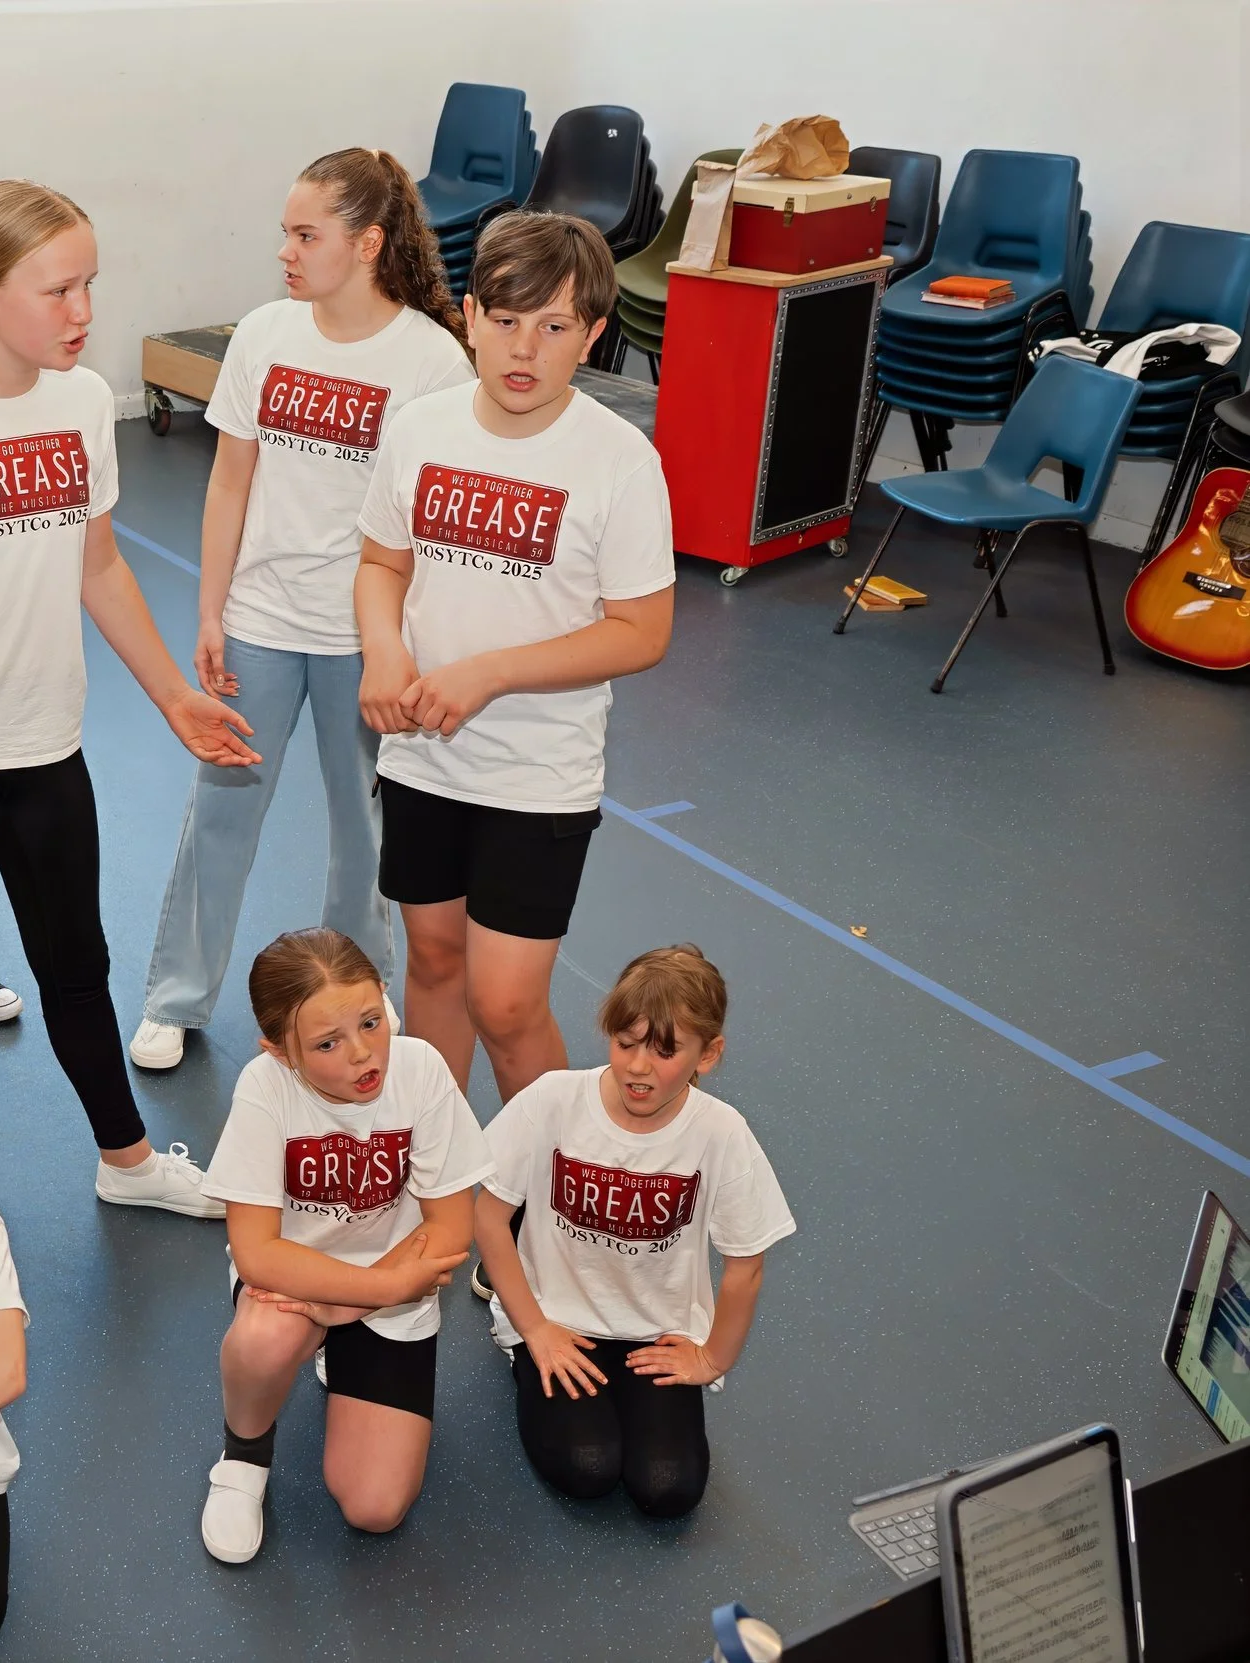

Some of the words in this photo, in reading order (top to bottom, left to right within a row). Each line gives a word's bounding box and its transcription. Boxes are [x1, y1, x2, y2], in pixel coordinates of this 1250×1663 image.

[294, 373, 307, 384] WE
[308, 377, 320, 387] GO
[322, 380, 362, 397] TOGETHER
[269, 382, 377, 433] GREASE
[280, 418, 298, 430] THE
[304, 424, 348, 441] MUSICAL
[2, 444, 14, 456] GO
[18, 438, 61, 454] TOGETHER
[260, 429, 327, 456] DOSYTCo
[334, 446, 370, 463] 2025
[451, 474, 465, 487] WE
[467, 477, 480, 488] GO
[484, 479, 533, 500] TOGETHER
[21, 493, 71, 509] MUSICAL
[424, 484, 552, 543] GREASE
[58, 508, 88, 527] 2025
[422, 524, 431, 535] 19
[437, 527, 459, 541] THE
[466, 533, 519, 554] MUSICAL
[530, 547, 543, 558] 59
[415, 541, 493, 571] DOSYTCo
[500, 560, 544, 581] 2025
[320, 1139, 333, 1152] WE
[338, 1137, 350, 1149] GO
[299, 1146, 409, 1194] GREASE
[581, 1168, 596, 1179] WE
[601, 1172, 614, 1183] GO
[620, 1174, 670, 1189] TOGETHER
[320, 1189, 342, 1200] THE
[349, 1189, 392, 1208] USICAL
[563, 1174, 689, 1225] GREASE
[555, 1214, 639, 1256] DOSYTCo
[578, 1214, 599, 1227] THE
[608, 1223, 664, 1237] MUSICAL
